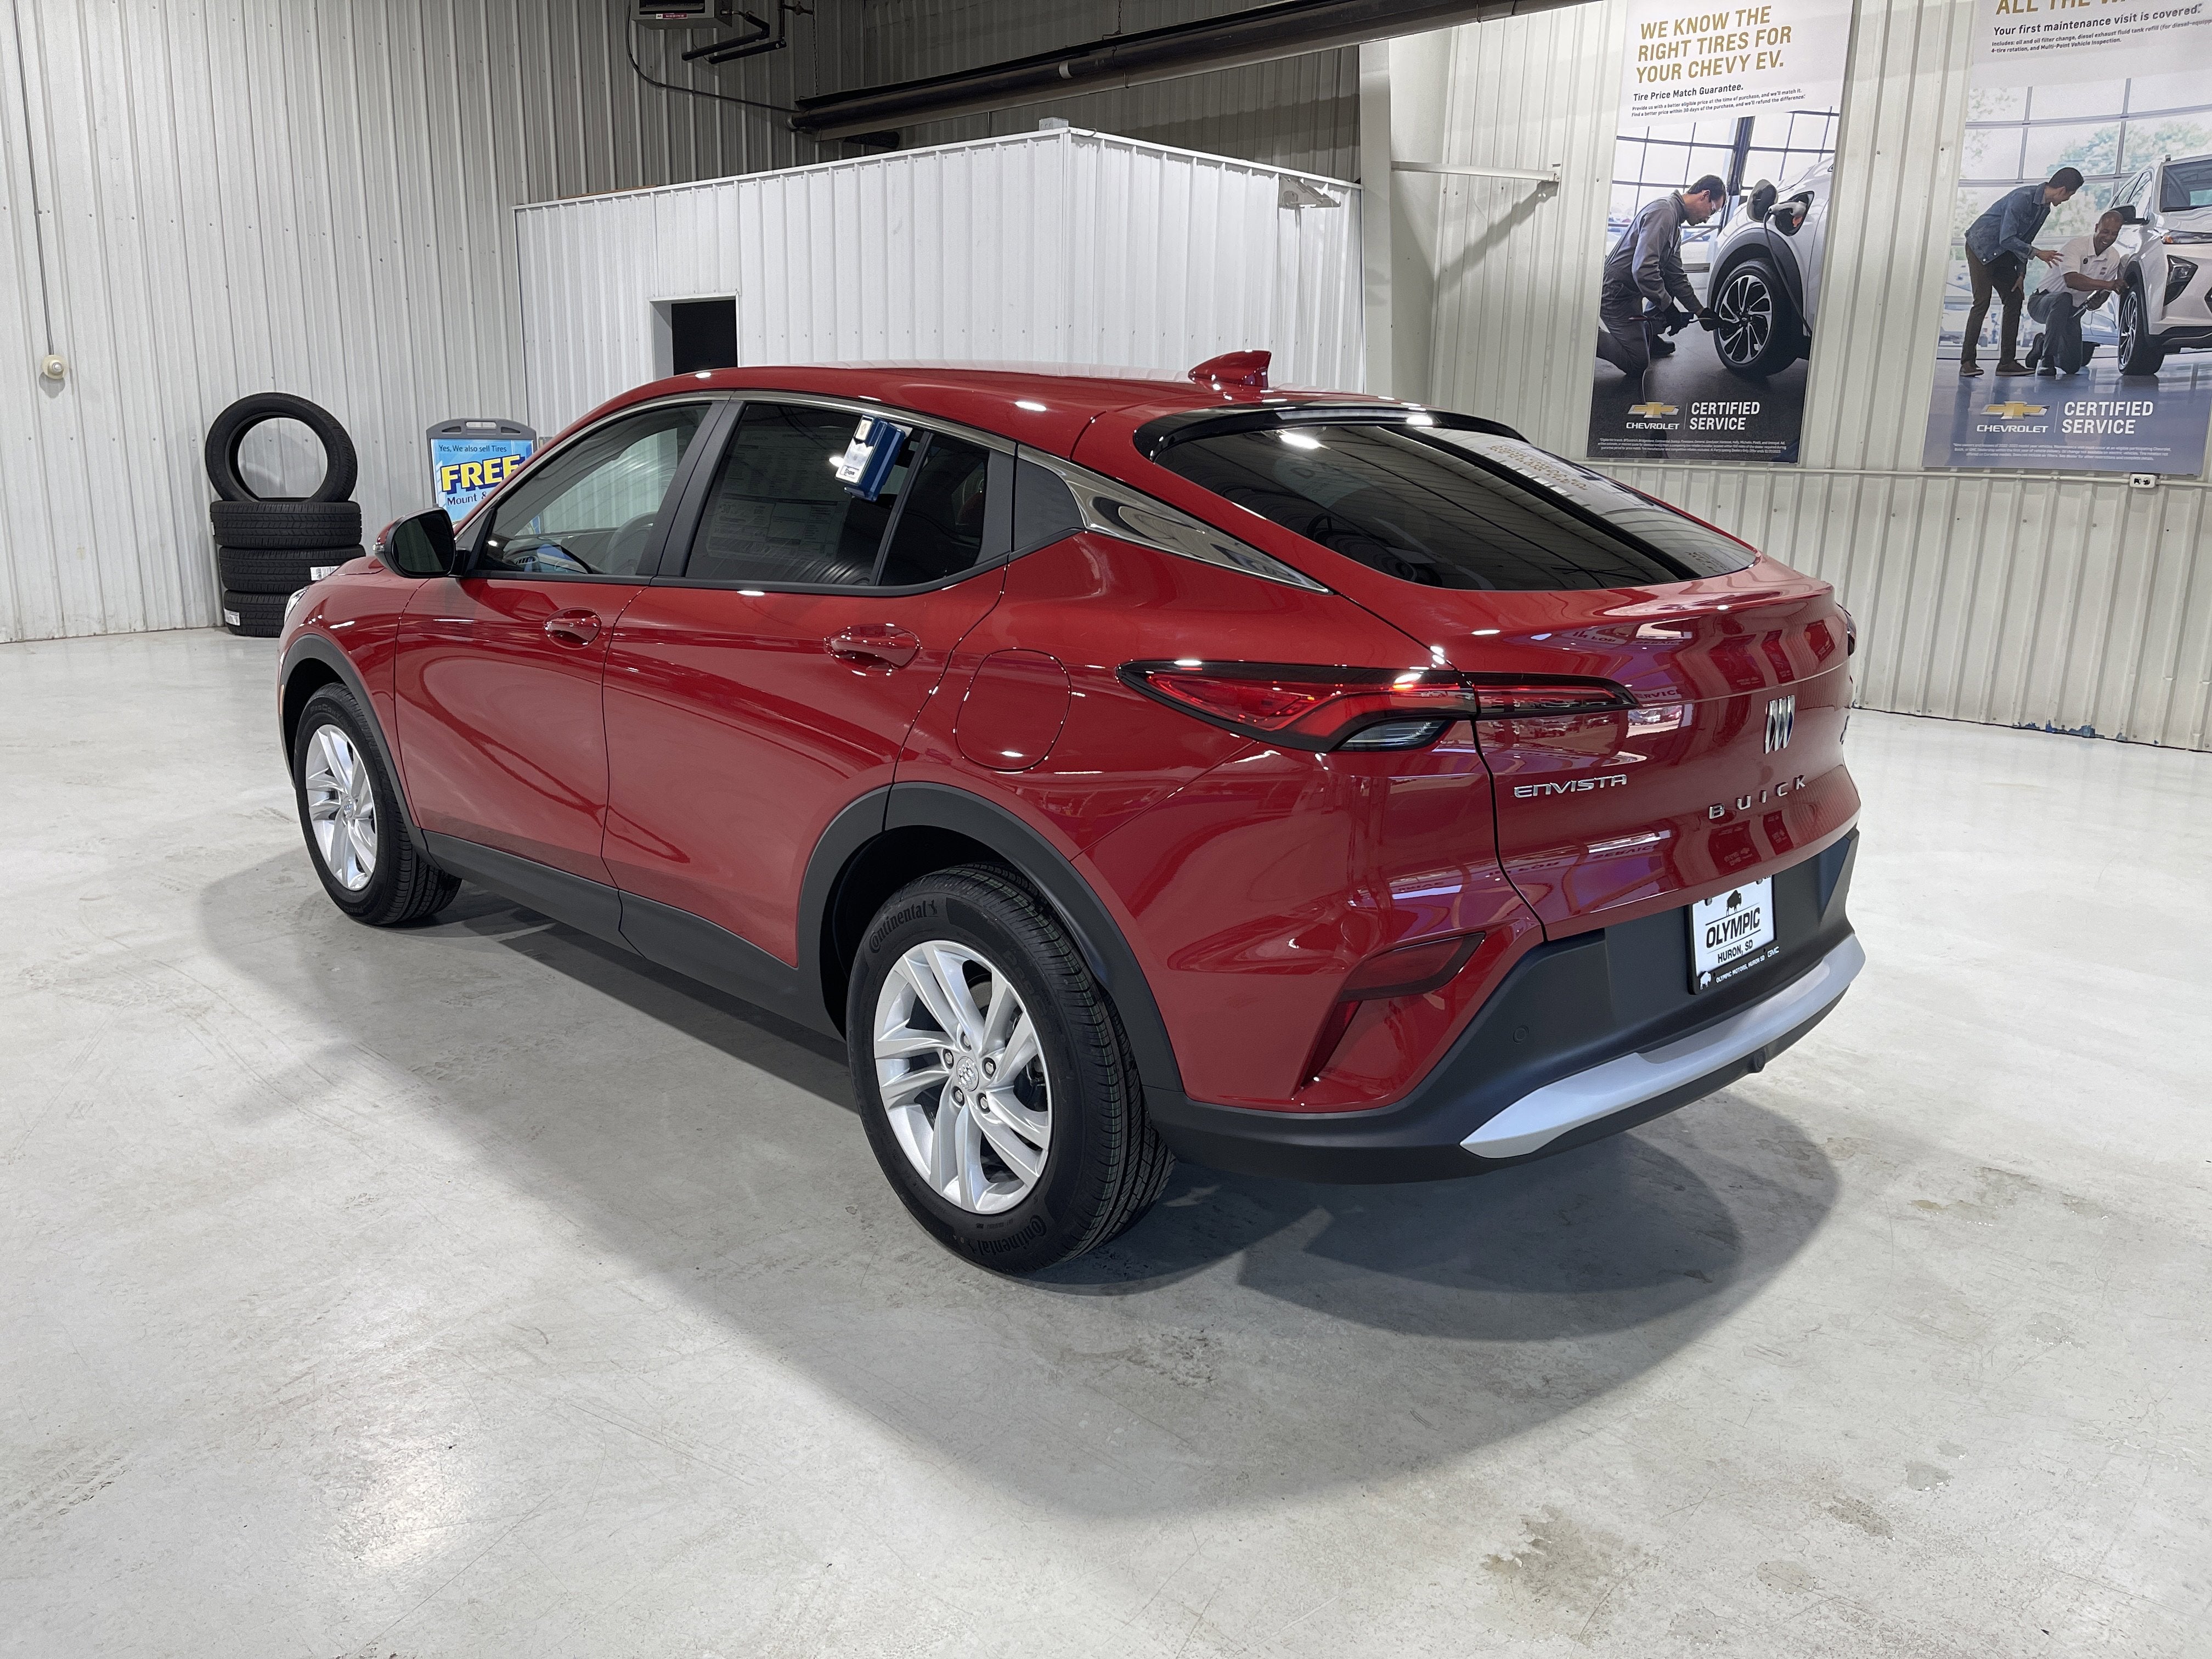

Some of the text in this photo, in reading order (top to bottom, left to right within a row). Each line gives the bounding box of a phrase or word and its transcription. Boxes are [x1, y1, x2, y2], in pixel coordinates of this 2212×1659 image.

[1996, 0, 2039, 15] ALL
[1640, 5, 1771, 40] WE KNOW THE
[1994, 27, 2016, 36] Your
[2019, 24, 2041, 34] first
[2044, 18, 2111, 32] maintenance
[2114, 13, 2137, 24] visit
[2140, 12, 2149, 21] is
[1638, 26, 1792, 62] RIGHT TIRES FOR
[1636, 50, 1784, 83] YOUR CHEVY EV.
[1633, 84, 1743, 101] Tire Price Match Guarantee.
[1691, 401, 1760, 415] CERTIFIED
[2064, 401, 2153, 417] CERTIFIED
[1626, 421, 1680, 430] CHEVROLET
[1689, 417, 1746, 431] SERVICE
[1976, 424, 2049, 433] CHEVROLET
[2061, 419, 2135, 435] SERVICE
[439, 444, 452, 453] Yes,
[441, 454, 523, 492] FREE
[447, 493, 477, 506] Mount
[1513, 774, 1628, 798] ENVISTA
[1708, 775, 1807, 820] BUICK
[869, 900, 927, 953] Continental
[1706, 907, 1760, 949] OLYMPIC
[1717, 939, 1753, 964] HURON, SD
[1767, 946, 1780, 958] GMC
[1716, 971, 1733, 983] OLYMPIC
[977, 1215, 1047, 1256] Continental
